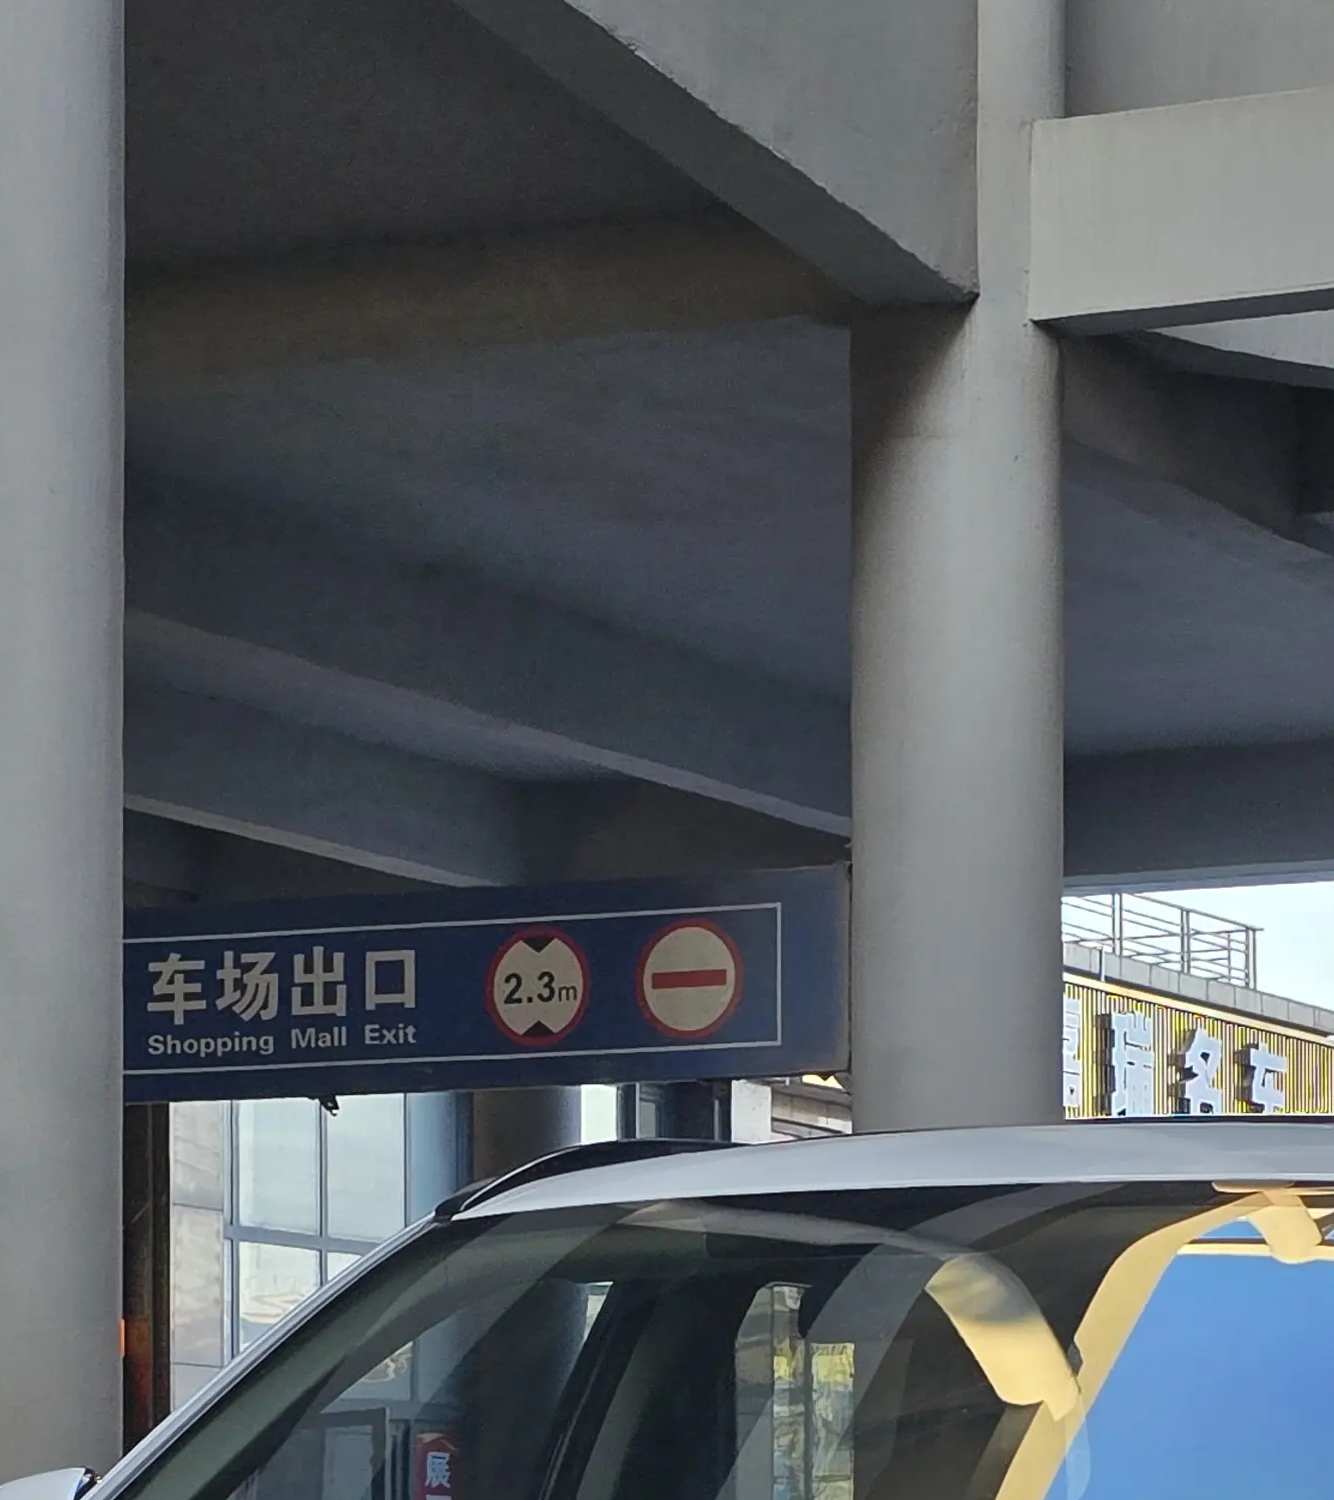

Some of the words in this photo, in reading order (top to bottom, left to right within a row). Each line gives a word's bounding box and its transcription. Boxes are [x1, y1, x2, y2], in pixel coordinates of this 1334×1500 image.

[147, 946, 416, 1025] 车场出口
[504, 970, 578, 1004] 2.3m
[147, 1031, 274, 1058] Shopping
[291, 1026, 347, 1049] Mall
[364, 1023, 417, 1045] Exit
